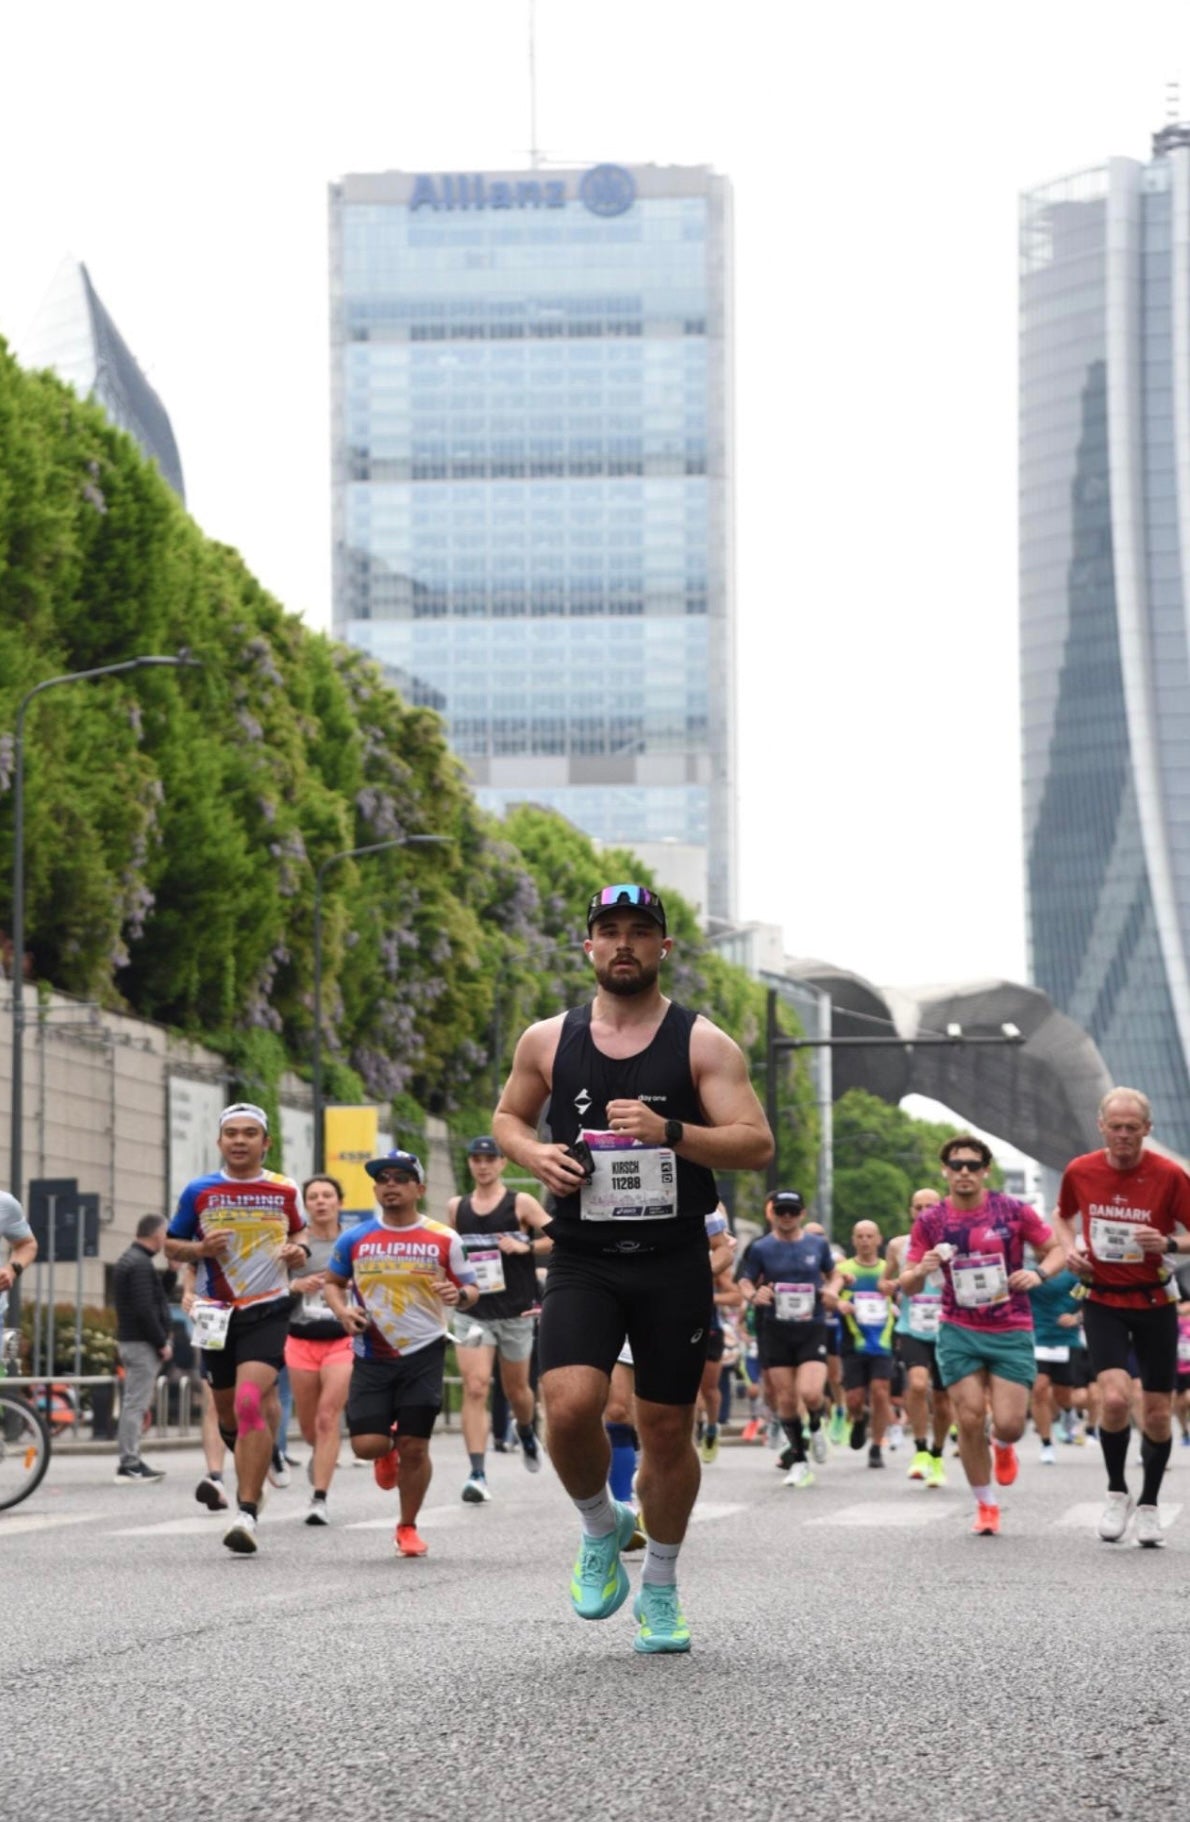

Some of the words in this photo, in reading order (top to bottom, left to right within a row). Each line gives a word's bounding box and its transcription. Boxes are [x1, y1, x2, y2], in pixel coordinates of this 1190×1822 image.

[410, 174, 566, 212] Allianz
[611, 1160, 639, 1175] KIRSCH
[611, 1176, 641, 1191] 11288
[208, 1193, 285, 1207] PILIPINO
[1089, 1203, 1152, 1222] DANMARK
[359, 1242, 440, 1257] PILIPINO
